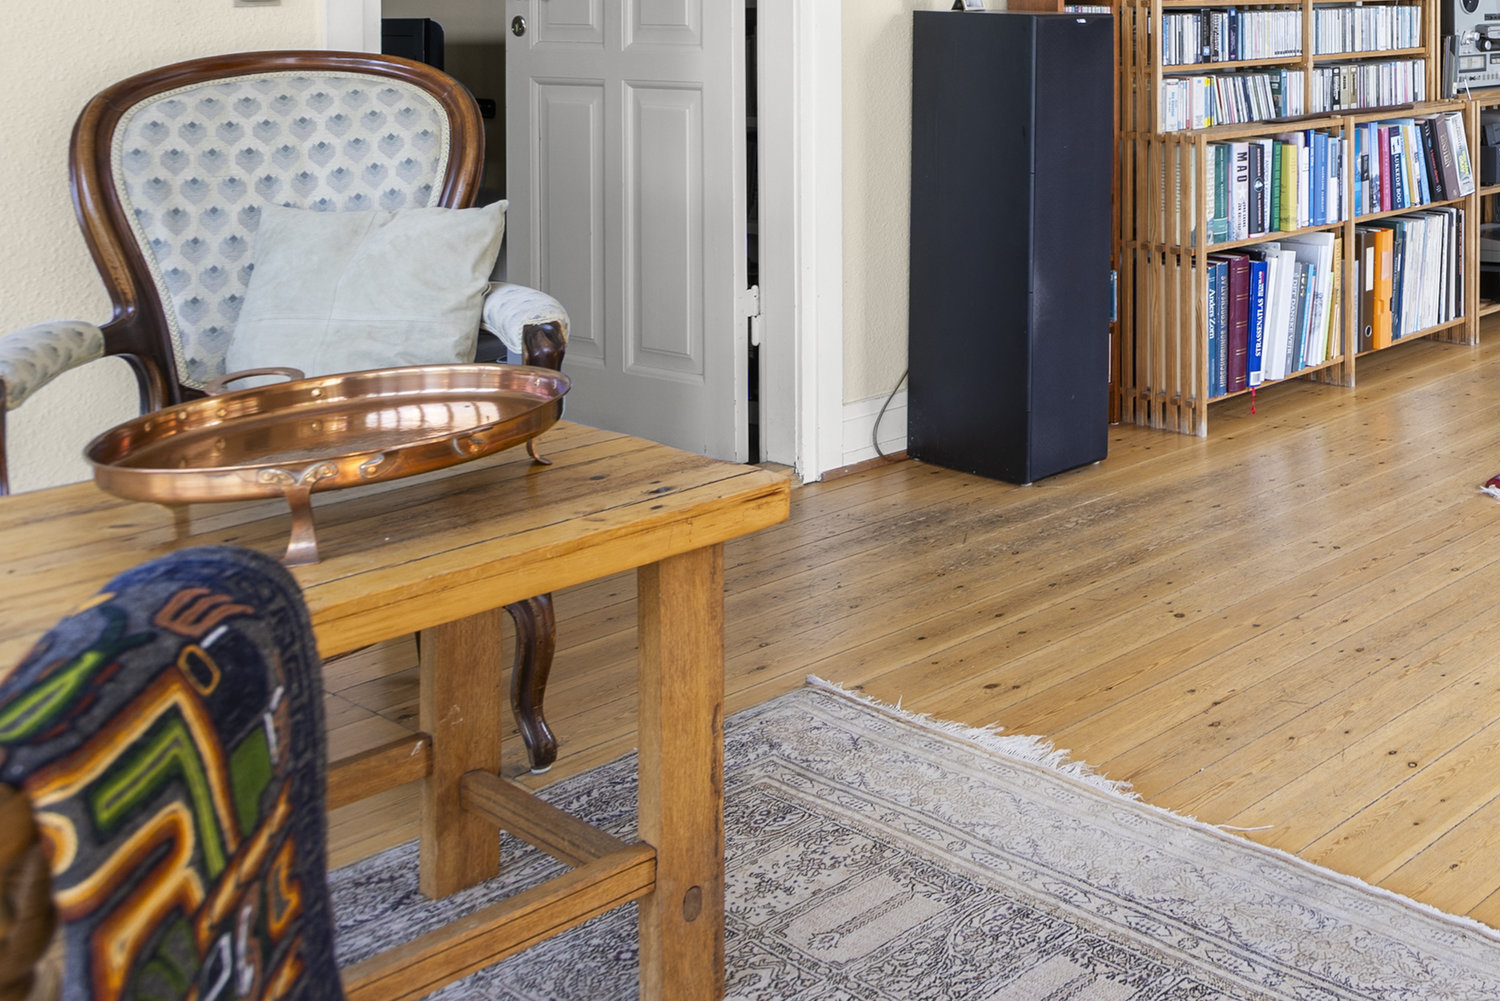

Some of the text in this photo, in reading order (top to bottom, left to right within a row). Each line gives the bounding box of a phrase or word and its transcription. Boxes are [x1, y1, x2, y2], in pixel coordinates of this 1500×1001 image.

[1237, 151, 1248, 184] MAO
[1440, 133, 1452, 169] EINSTEIN
[1291, 279, 1299, 298] DET
[1255, 297, 1264, 357] STRASSENATLAS
[1289, 298, 1297, 333] DANSKE
